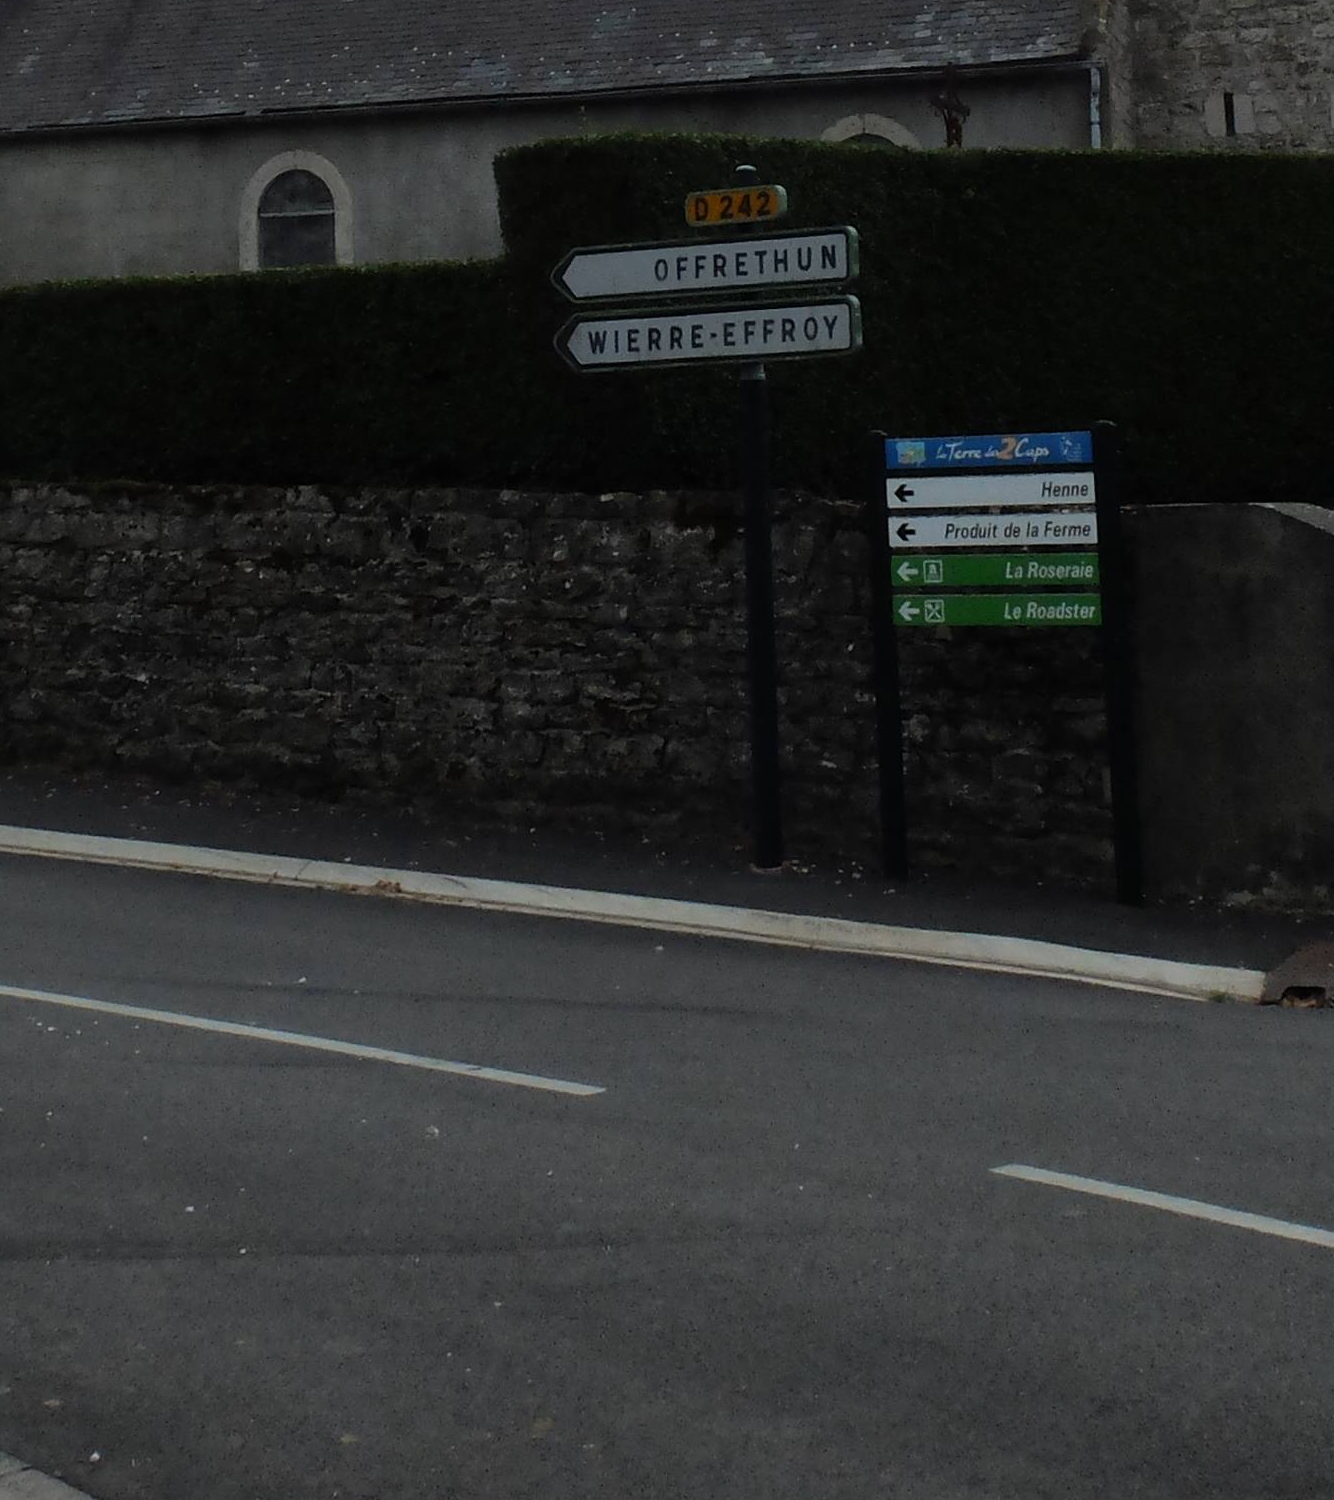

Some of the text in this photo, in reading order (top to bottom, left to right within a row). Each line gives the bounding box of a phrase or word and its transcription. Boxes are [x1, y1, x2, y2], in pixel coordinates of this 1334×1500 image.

[654, 245, 837, 281] OFFRETHUN
[588, 315, 839, 355] WIERRE-EFFROY
[1014, 437, 1050, 463] Caps
[1041, 481, 1089, 499] Henne
[944, 521, 1091, 540] Produit de la Ferme
[1005, 561, 1094, 579] La Roseraie
[1004, 601, 1096, 619] Le Roadster
